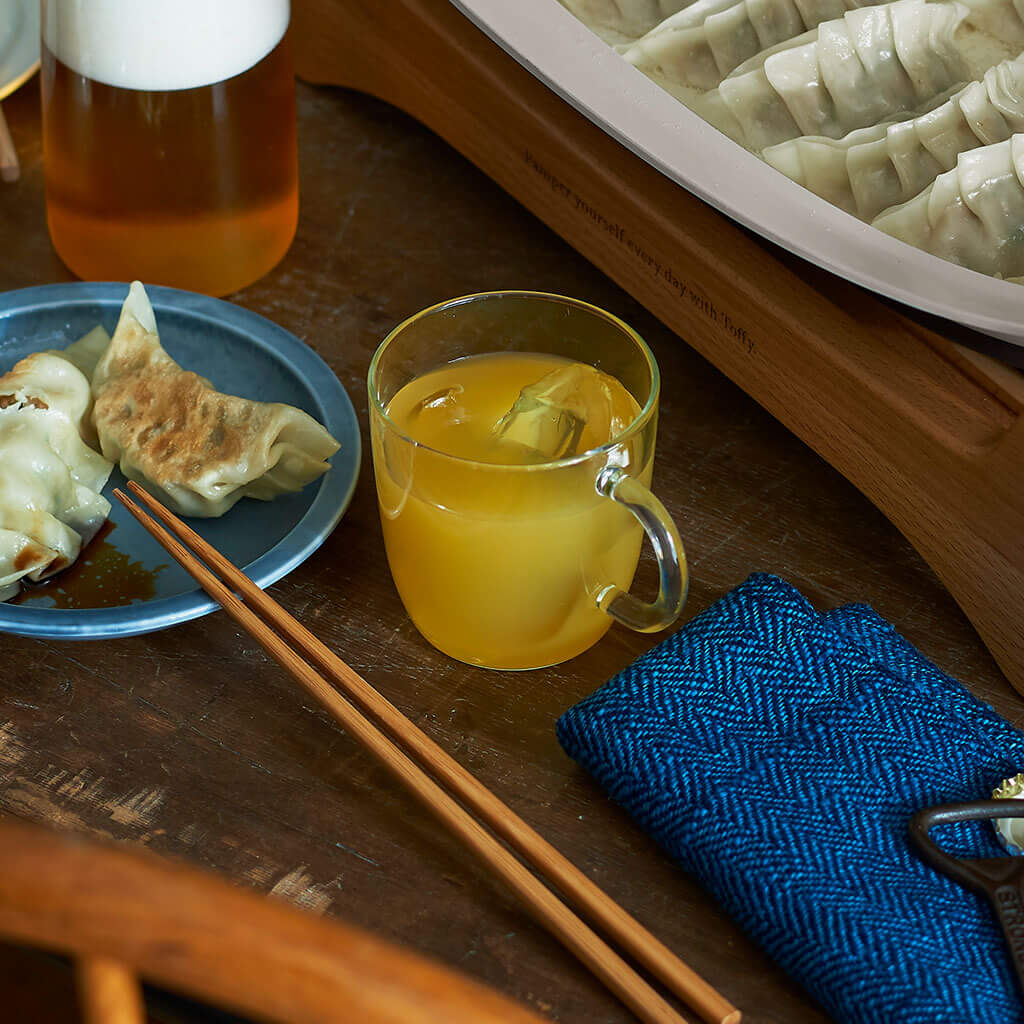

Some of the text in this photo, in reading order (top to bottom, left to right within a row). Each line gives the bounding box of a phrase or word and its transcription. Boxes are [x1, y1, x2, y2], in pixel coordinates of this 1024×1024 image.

[574, 195, 625, 241] yourself
[627, 239, 662, 276] every
[664, 268, 687, 297] day
[688, 289, 717, 320] with
